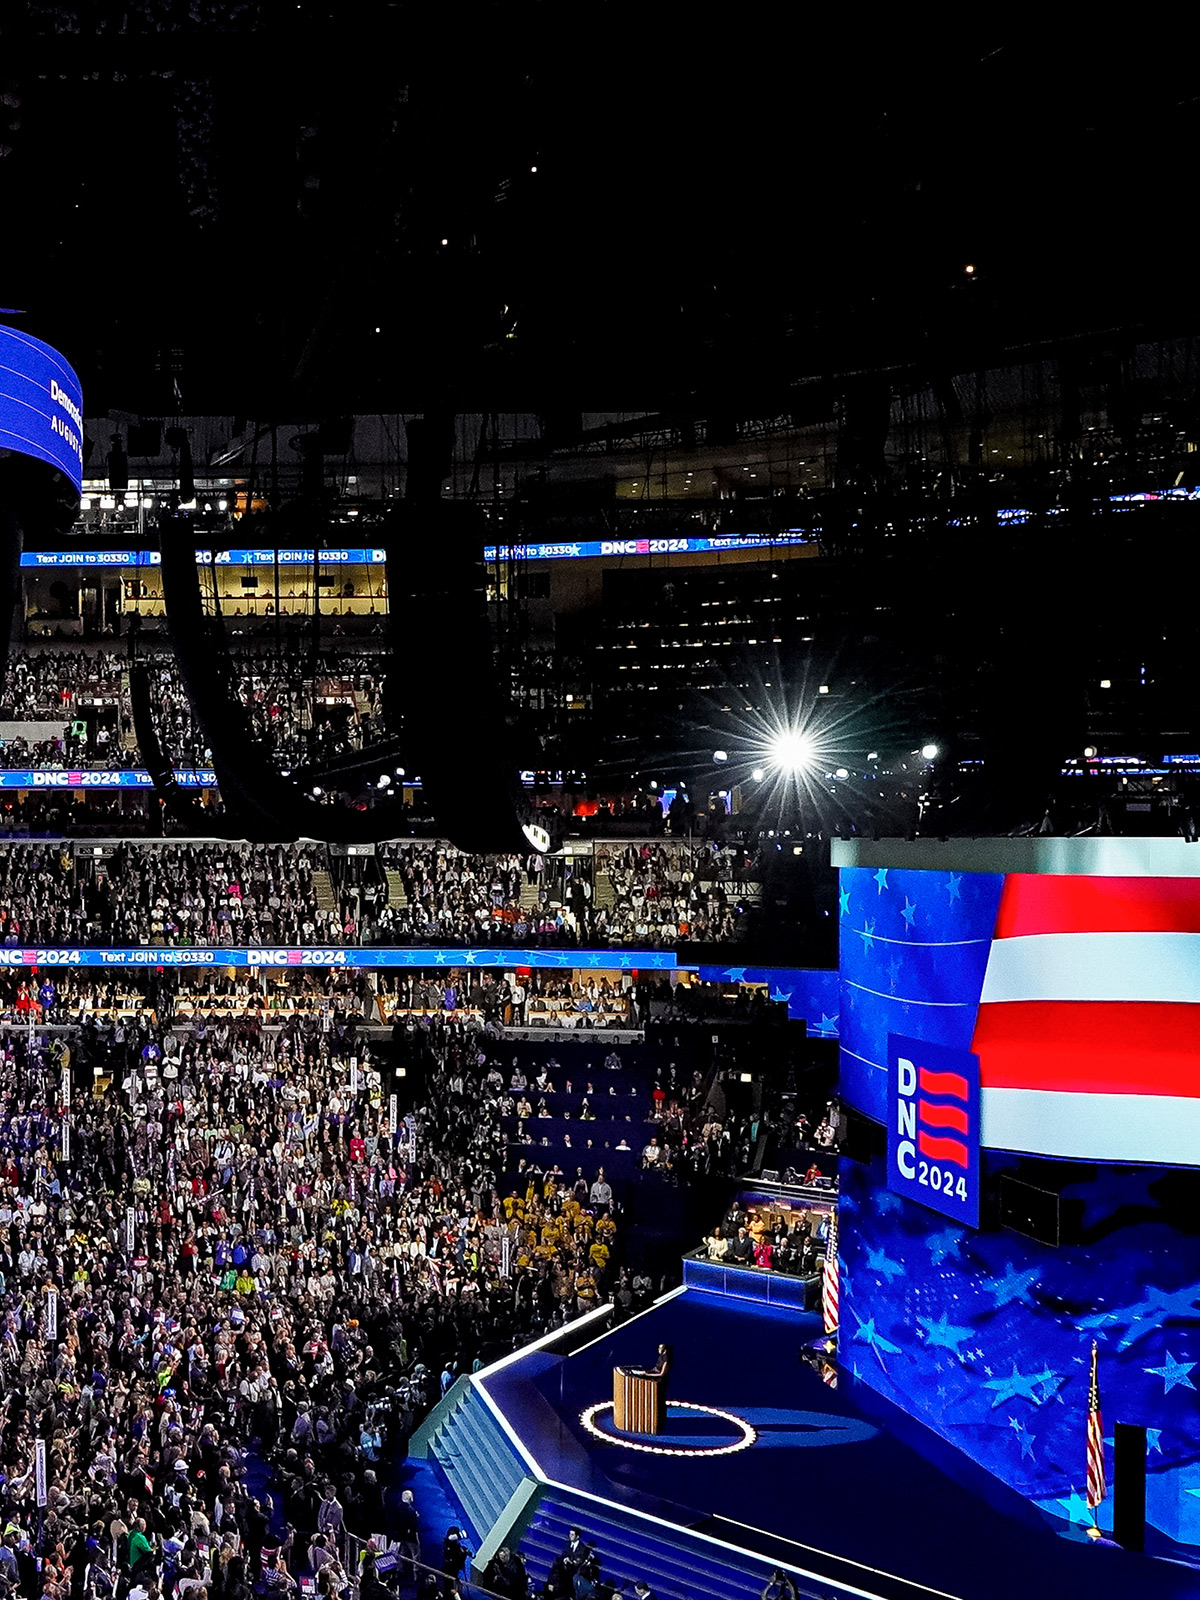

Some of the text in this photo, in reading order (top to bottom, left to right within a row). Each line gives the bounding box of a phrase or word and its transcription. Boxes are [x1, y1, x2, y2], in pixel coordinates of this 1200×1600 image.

[526, 547, 537, 556] to
[601, 541, 636, 553] DNC
[650, 539, 688, 551] 2024
[36, 554, 129, 563] Text JOIN to 30330
[33, 773, 69, 785] DNC
[81, 774, 120, 785] 2024
[36, 951, 81, 964] 2024
[100, 952, 126, 962] Text
[128, 952, 157, 962] JOIN
[160, 952, 173, 962] to
[174, 952, 213, 963] 30330
[247, 951, 287, 964] DNC
[302, 951, 346, 964] 2024
[897, 1057, 916, 1180] DNC
[918, 1161, 968, 1202] 2024
